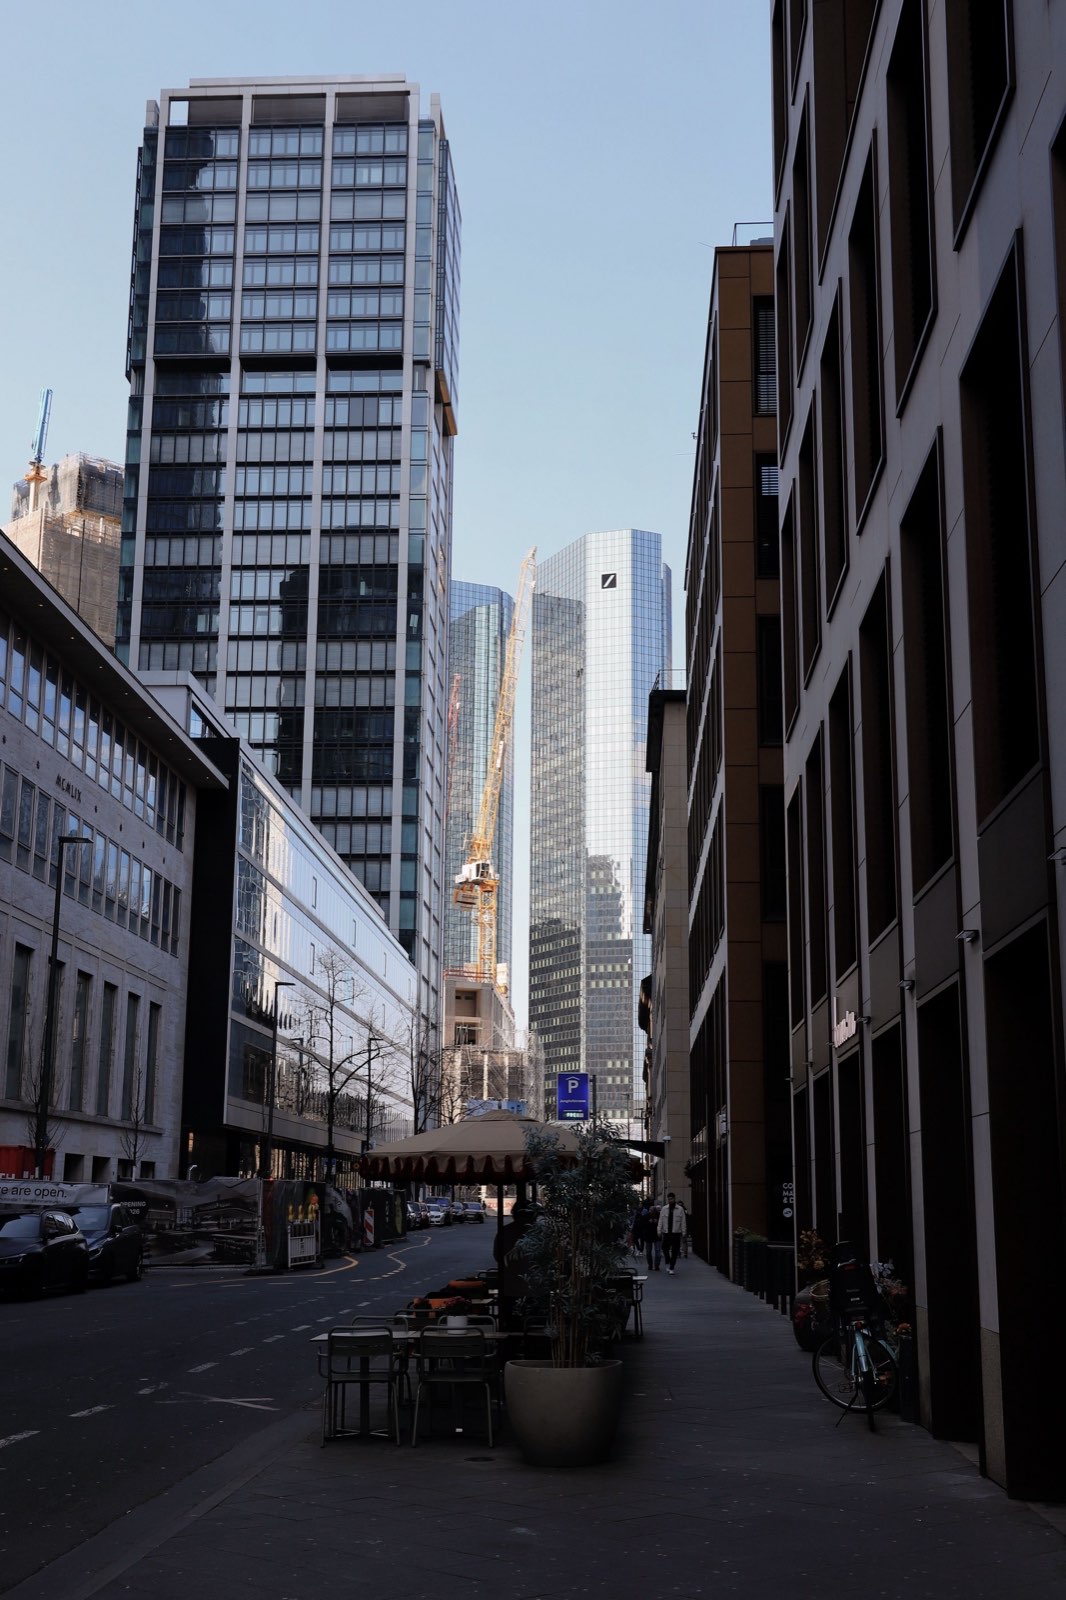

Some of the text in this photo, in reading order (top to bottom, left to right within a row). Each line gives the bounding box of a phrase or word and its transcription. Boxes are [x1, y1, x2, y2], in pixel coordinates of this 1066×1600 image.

[567, 1080, 579, 1094] P
[0, 1186, 68, 1199] e are open.
[120, 1200, 147, 1208] OPENING
